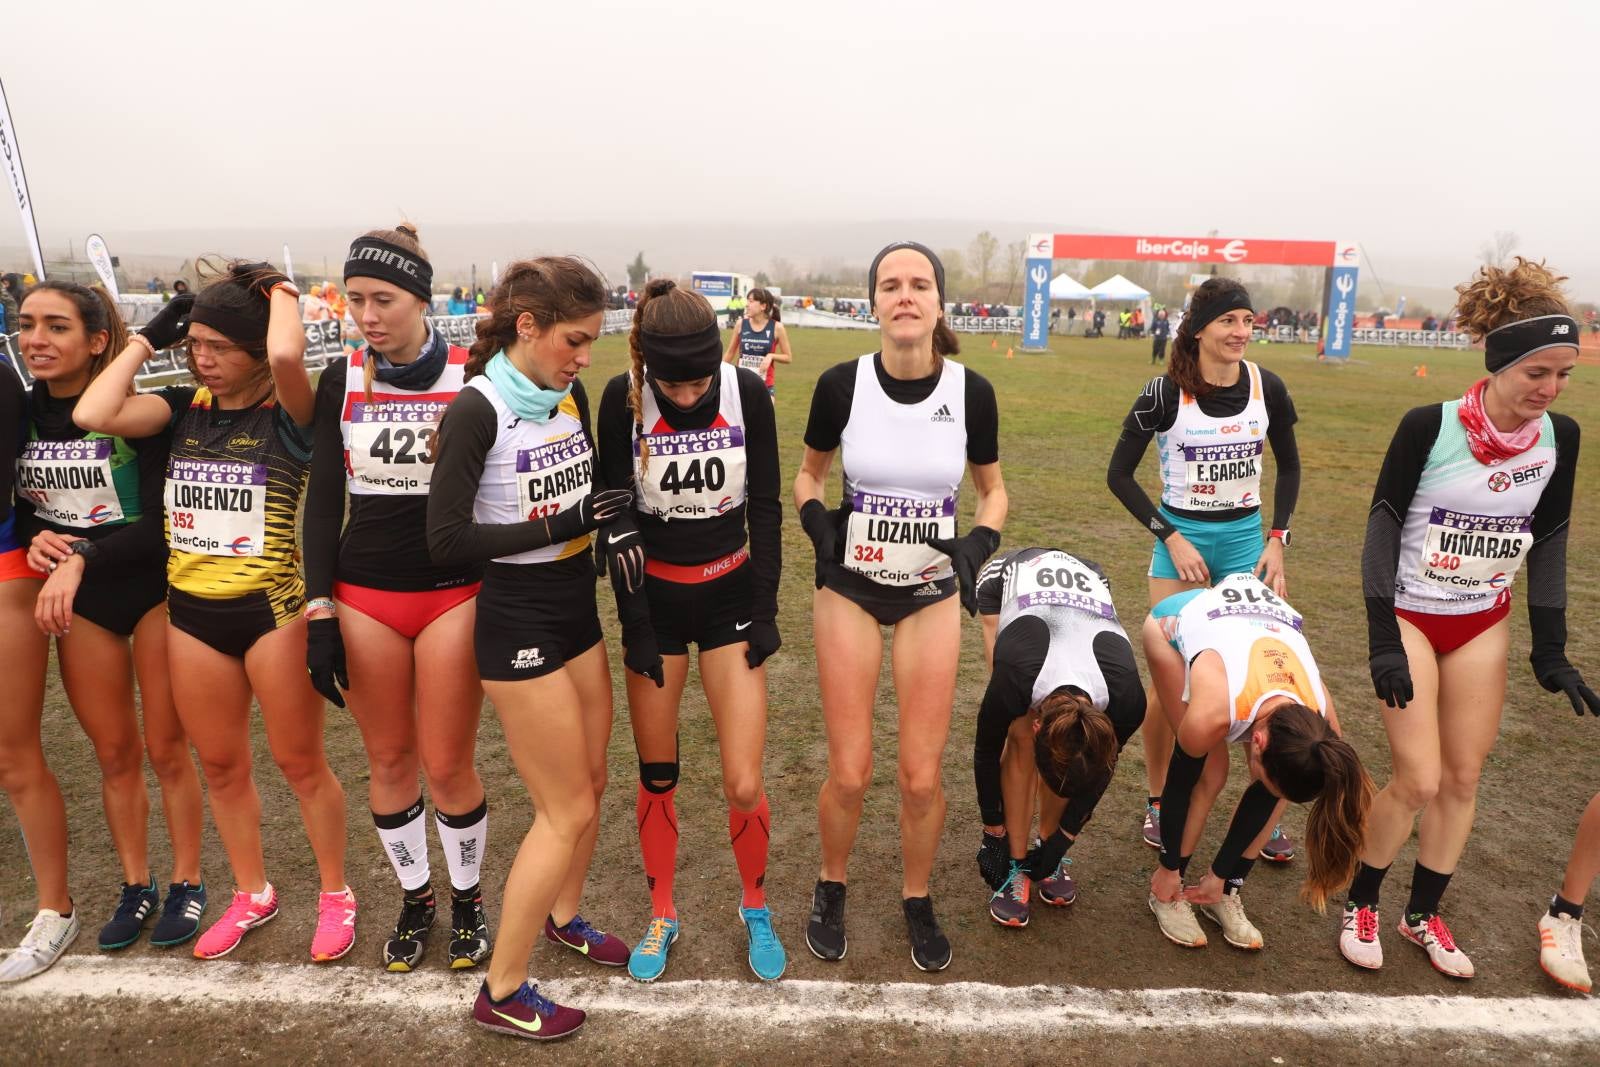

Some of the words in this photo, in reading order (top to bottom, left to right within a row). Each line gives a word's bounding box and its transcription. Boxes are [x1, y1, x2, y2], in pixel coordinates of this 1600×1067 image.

[1136, 239, 1209, 259] iberCaja
[1030, 293, 1044, 340] iberCaja
[1332, 302, 1348, 350] iberCaja
[363, 412, 436, 422] BURGO
[646, 429, 730, 445] DIPUTACIÓN
[1186, 427, 1217, 436] hummel
[1220, 424, 1242, 434] GO
[370, 428, 438, 464] 423
[648, 438, 732, 456] BURGOS
[1195, 442, 1257, 454] DIPUTACIÓN
[1195, 449, 1256, 461] BURGOS
[530, 441, 589, 471] BURGOS
[174, 460, 253, 474] DIPUTACIÓN
[660, 456, 725, 495] 440
[1512, 466, 1543, 484] BAT
[18, 466, 107, 490] CASANOVA
[173, 469, 253, 485] BURGOS
[528, 457, 593, 503] CARRER
[174, 484, 253, 512] LORENZO
[1191, 484, 1216, 495] 323
[528, 502, 560, 521] 417
[862, 503, 944, 518] BURGOS
[1444, 511, 1525, 525] DIPUTACIÓN
[172, 511, 194, 529] 352
[1442, 518, 1522, 533] BURGOS
[867, 518, 939, 545] LOZANO
[173, 533, 219, 551] iberCaja
[1440, 530, 1523, 559] VIÑARAS
[854, 545, 884, 562] 324
[1429, 552, 1461, 571] 340
[703, 558, 731, 576] NIKE
[1036, 567, 1092, 593] 309
[1424, 569, 1480, 588] iberCaja
[1221, 588, 1282, 606] 316
[517, 648, 539, 660] PA
